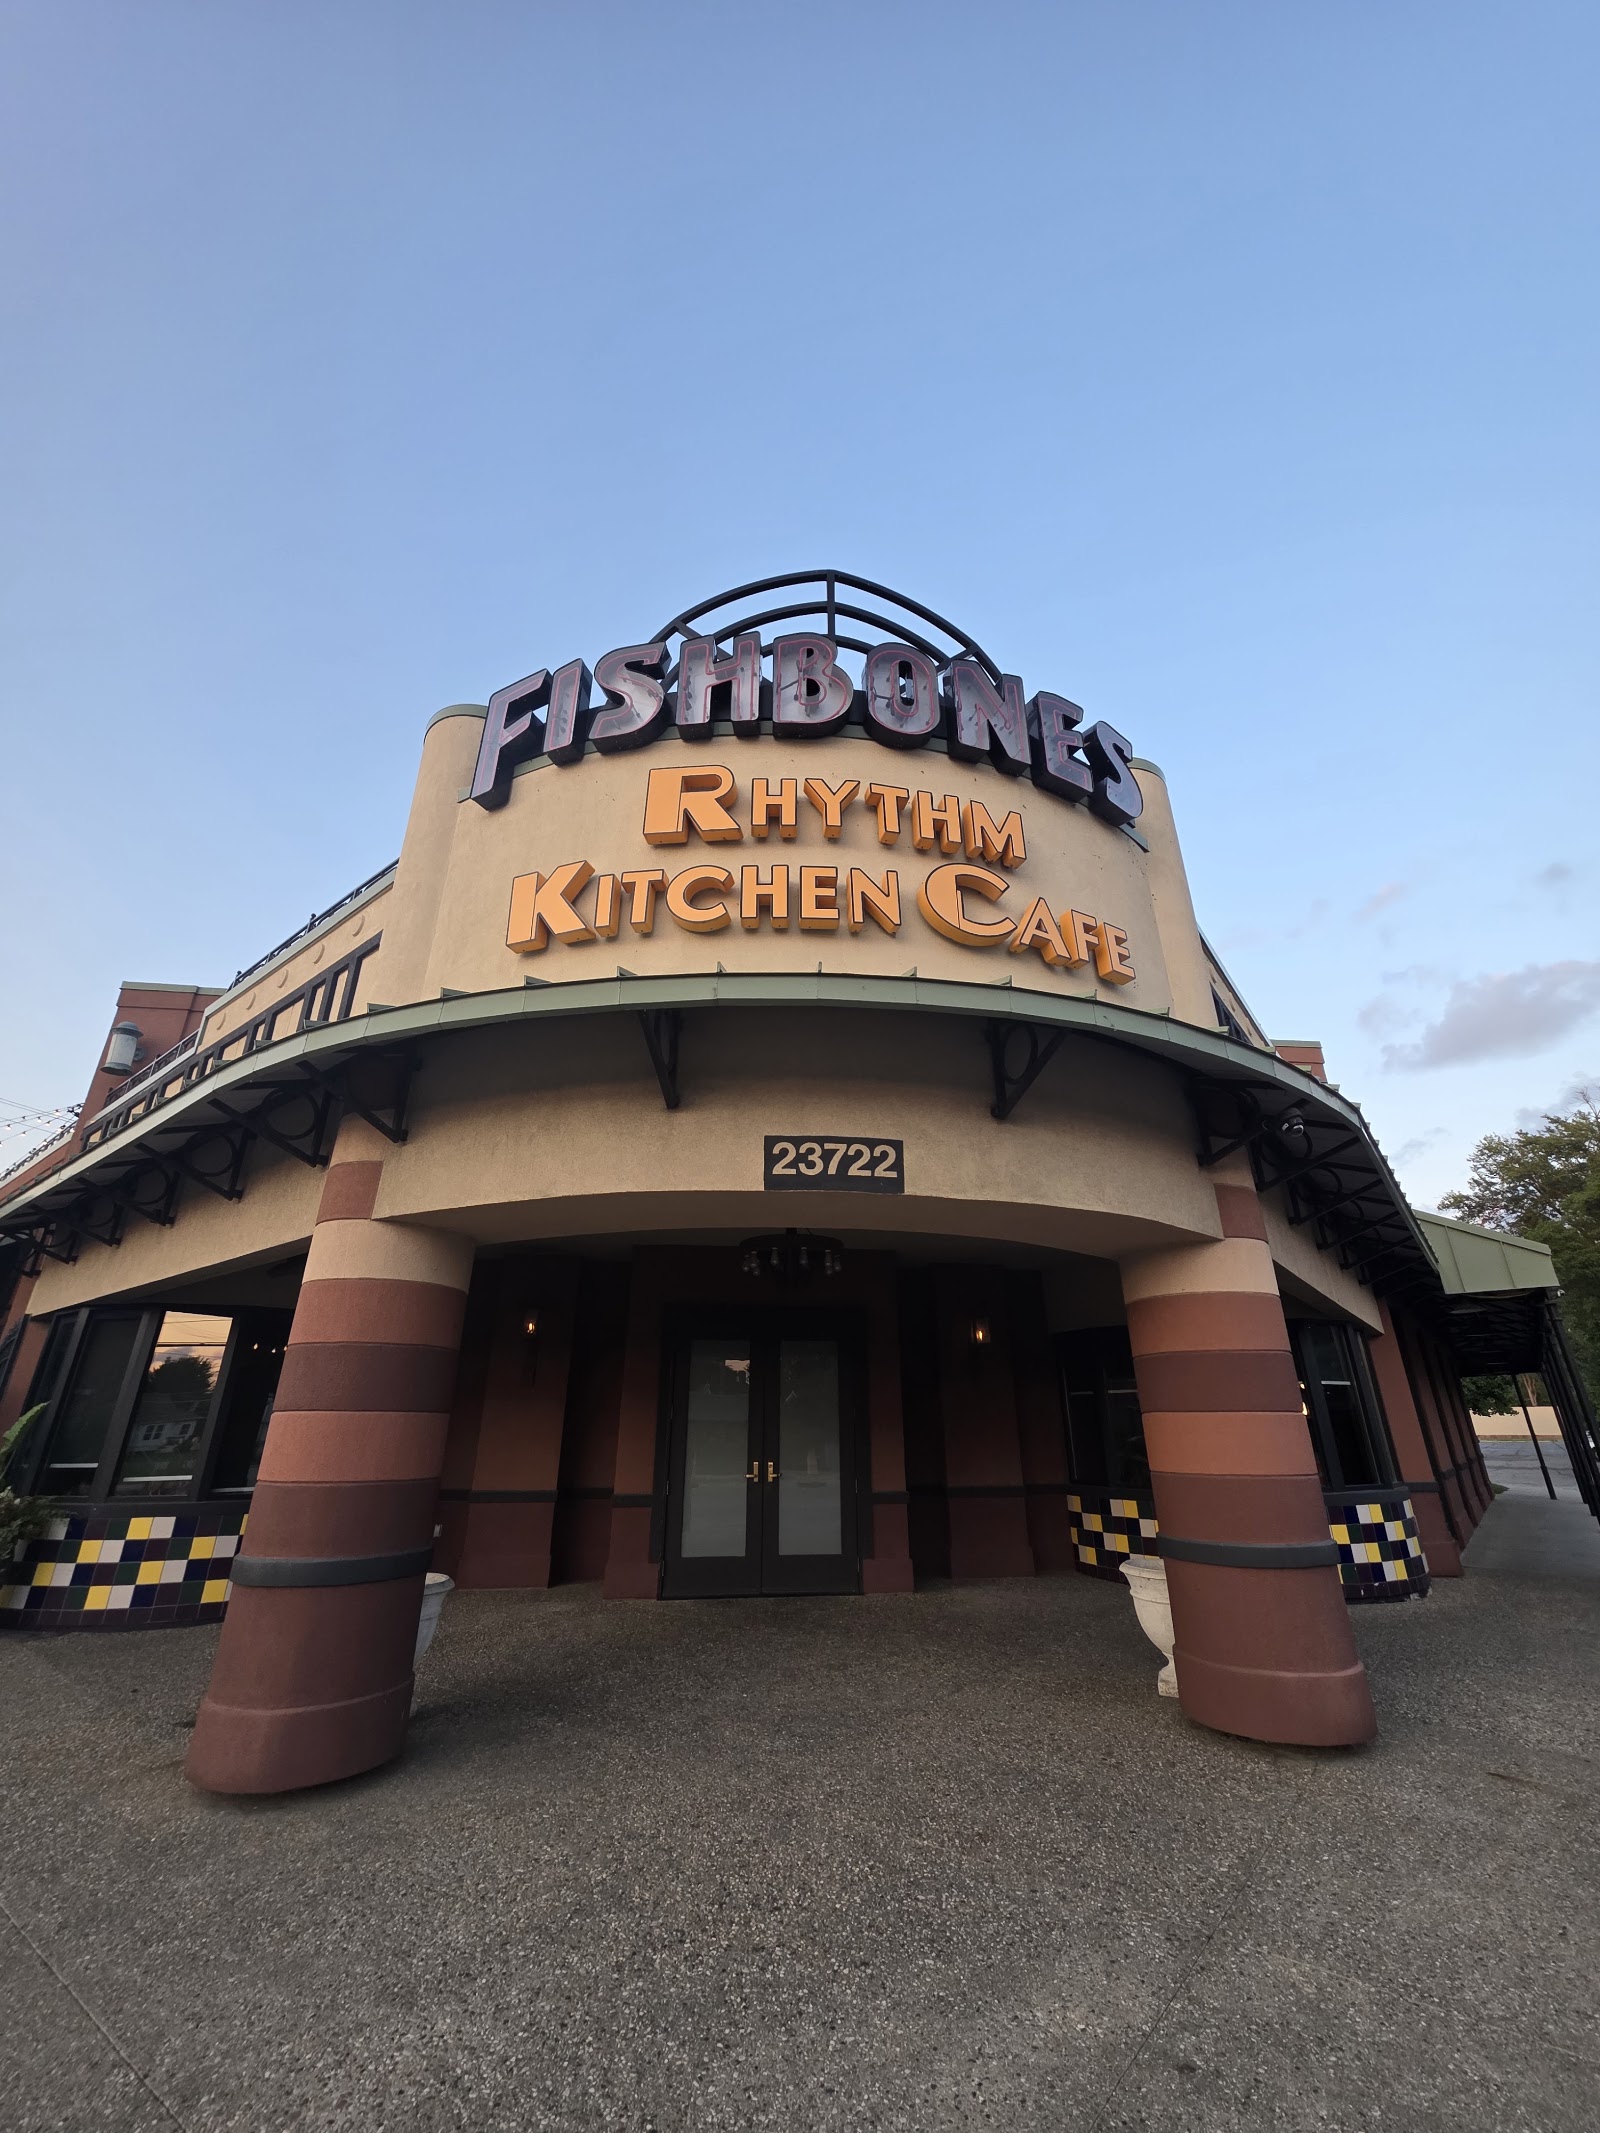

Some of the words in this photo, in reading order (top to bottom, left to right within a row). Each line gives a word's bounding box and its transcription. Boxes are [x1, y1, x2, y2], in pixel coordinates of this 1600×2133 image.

[469, 632, 1144, 827] FISHBONES
[643, 765, 1027, 869] RHYTHM
[505, 860, 901, 954] KITCHEN
[918, 864, 1136, 985] CAFE
[772, 1142, 897, 1178] 23722
